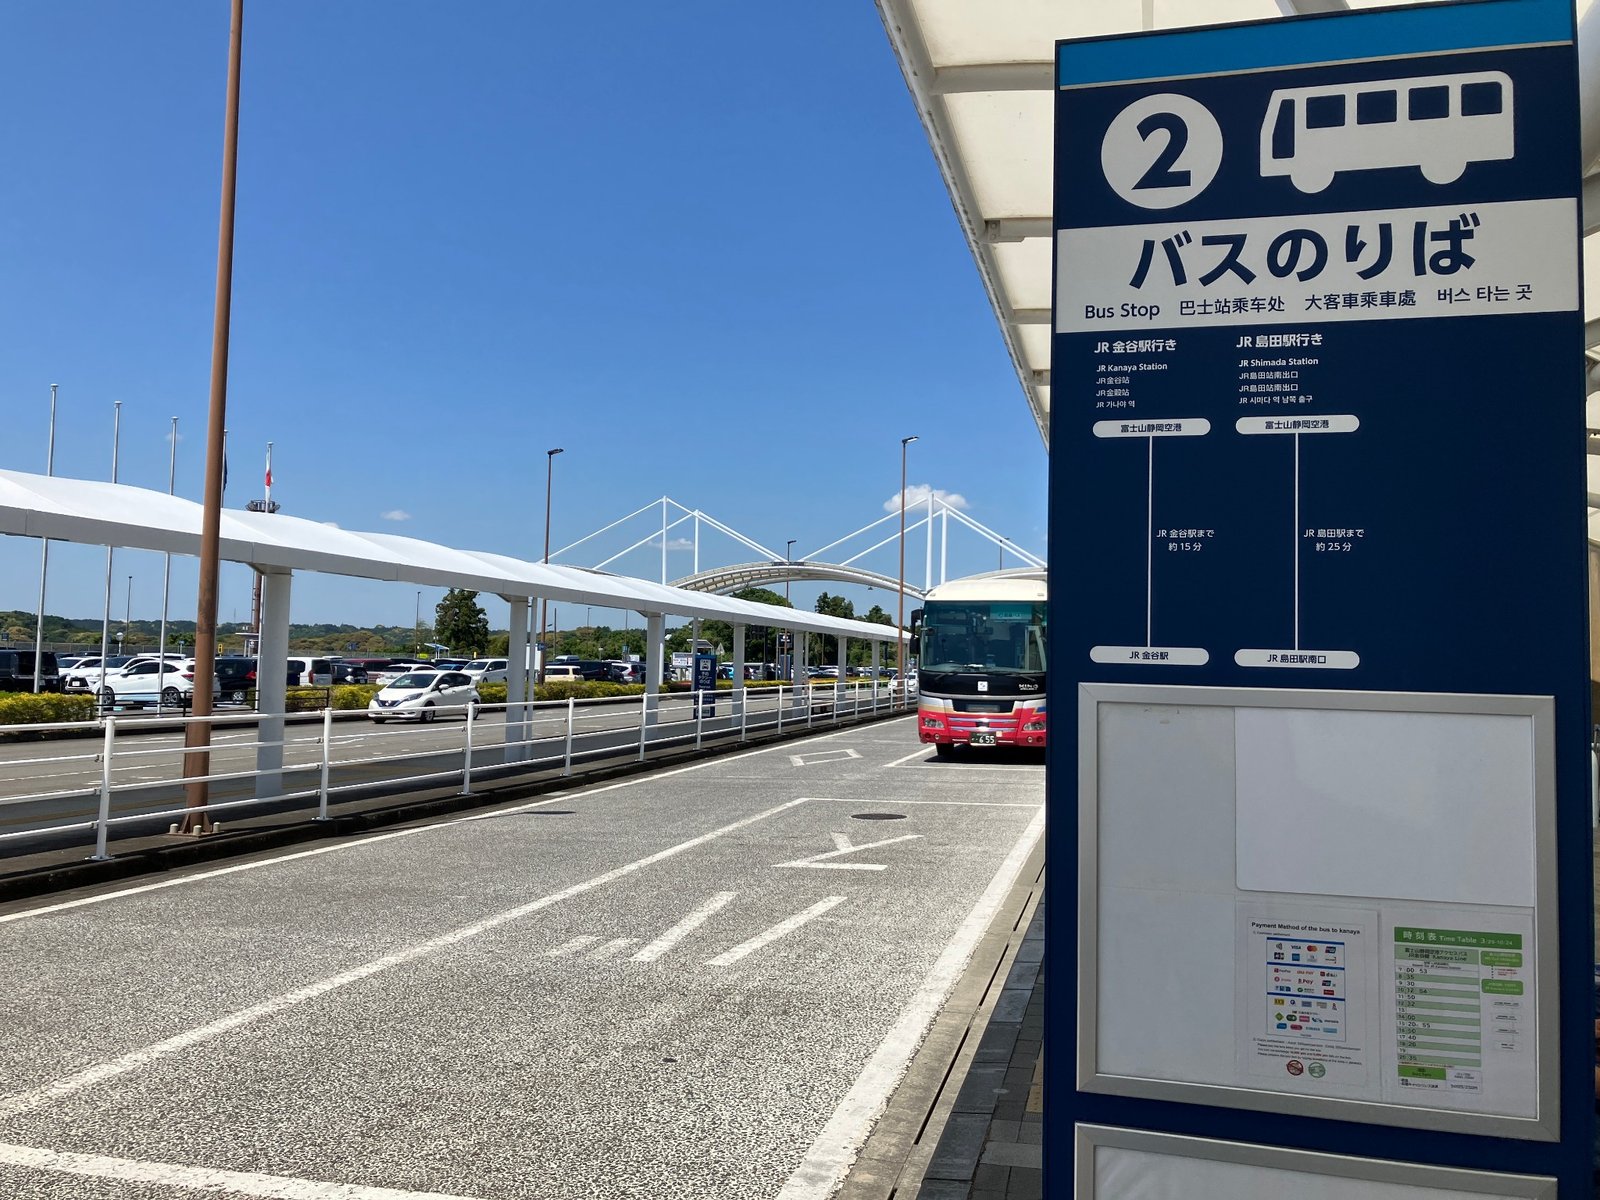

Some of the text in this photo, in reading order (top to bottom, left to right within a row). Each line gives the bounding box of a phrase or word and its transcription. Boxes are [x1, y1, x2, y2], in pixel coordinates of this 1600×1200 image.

[1131, 111, 1192, 190] 2
[1128, 211, 1481, 290] バスのりば
[1436, 282, 1533, 305] 버스 타는 곳
[1084, 301, 1161, 321] Bus Stop
[1236, 333, 1323, 348] JR 島田駅行き
[1094, 339, 1177, 354] JR 金谷駅行き
[1096, 362, 1168, 373] JR Kanaya Station
[1238, 357, 1319, 368] JR Shimada Station
[1238, 397, 1248, 405] JR
[1156, 528, 1215, 539] JR 金谷駅まで
[1303, 528, 1365, 539] JR 島田駅まで
[1129, 651, 1169, 661] JR 金谷駅
[1266, 654, 1279, 663] JR
[1251, 921, 1277, 930] Payment
[1339, 928, 1361, 936] kanaya
[1457, 936, 1477, 944] Table
